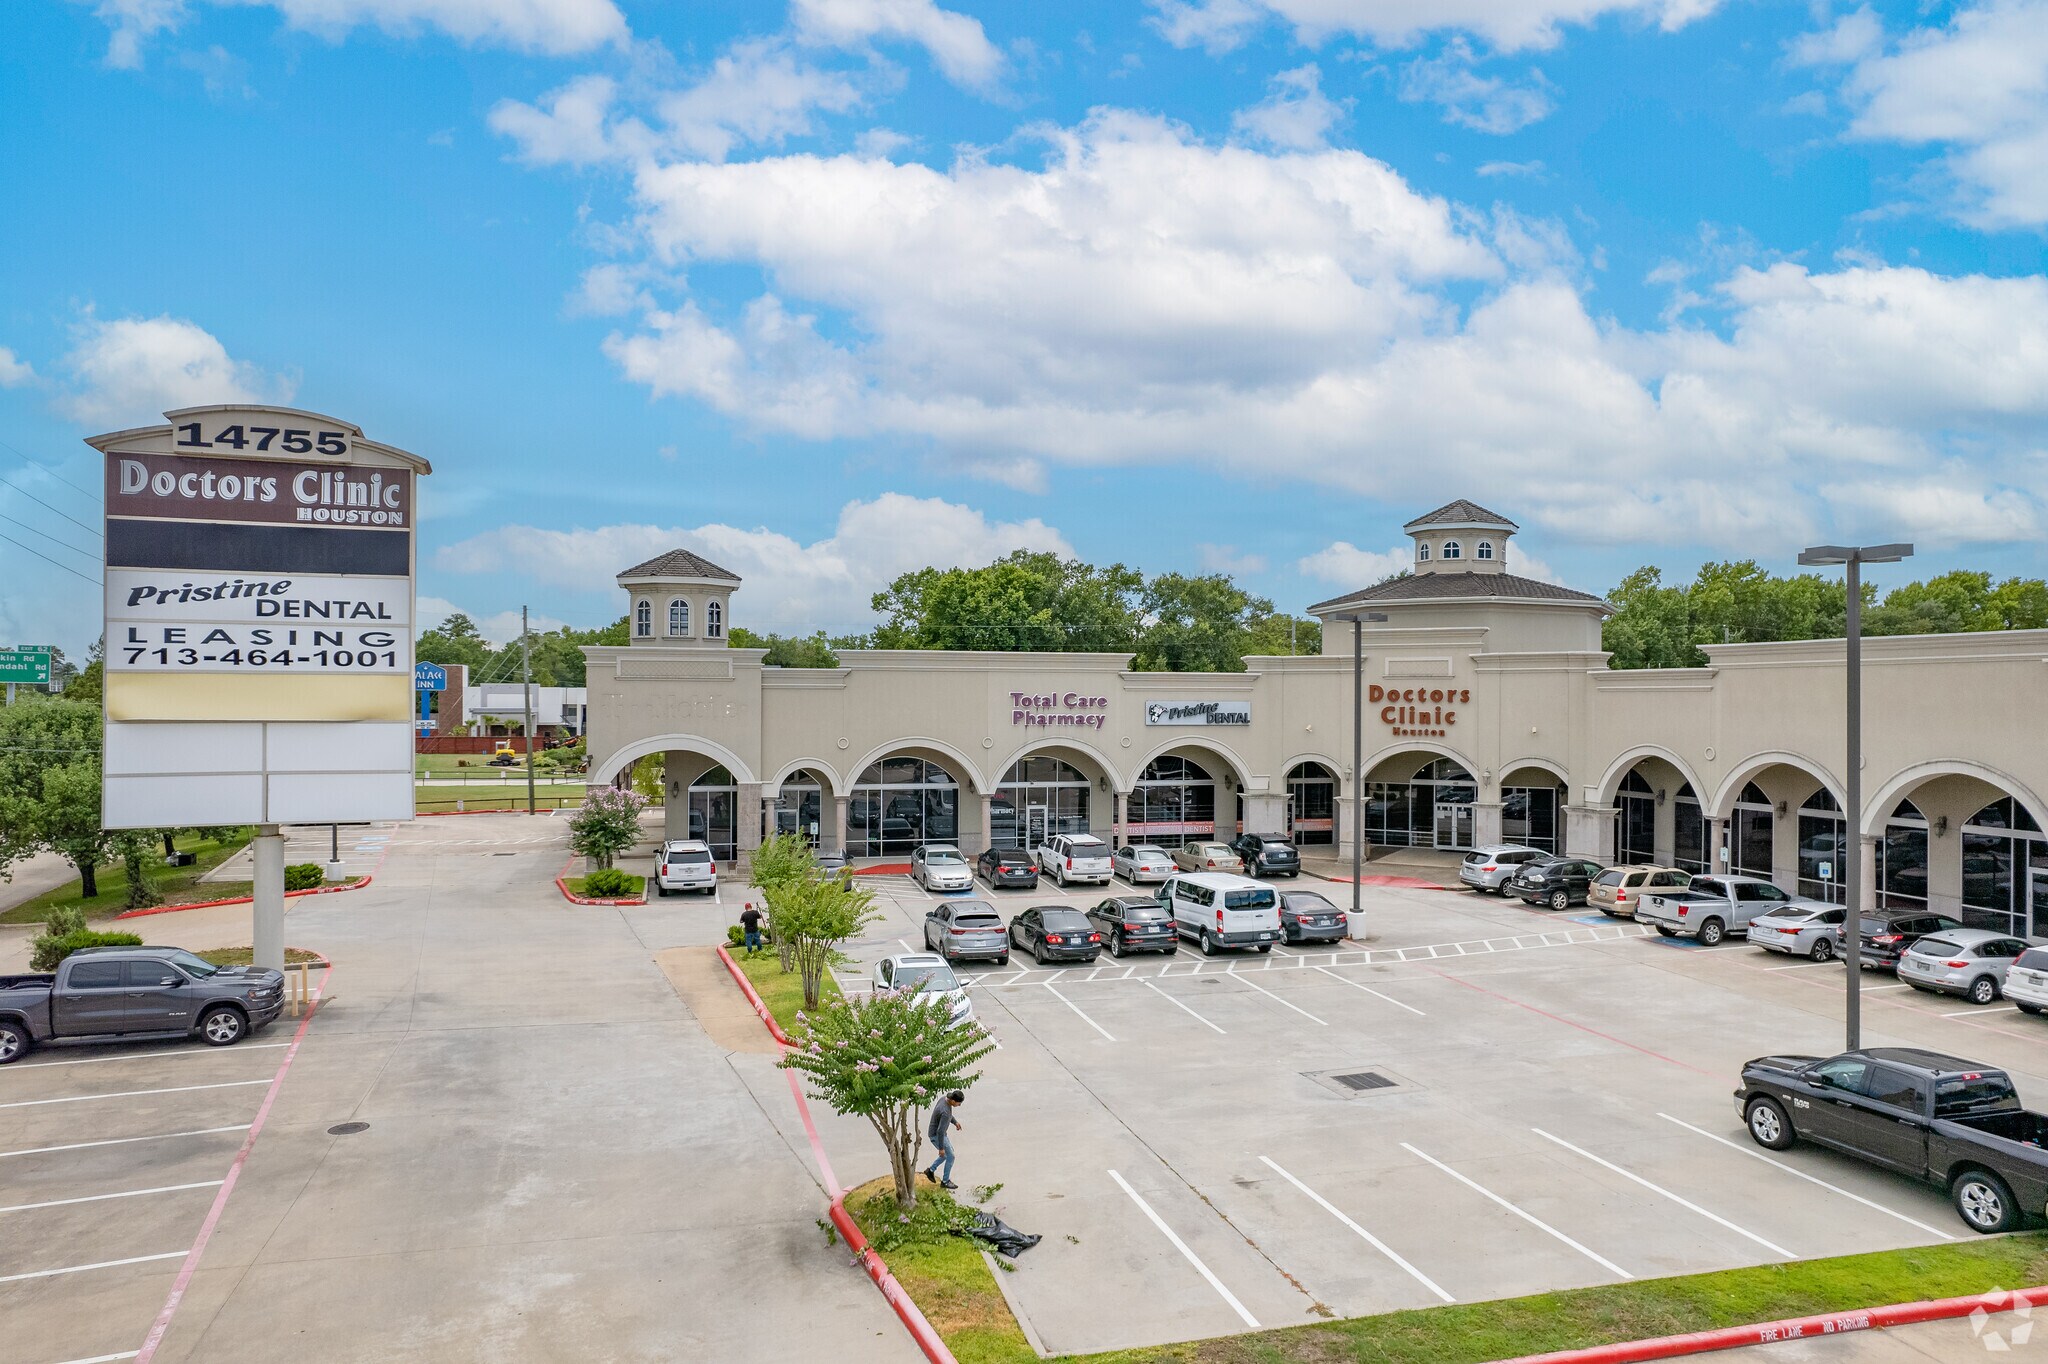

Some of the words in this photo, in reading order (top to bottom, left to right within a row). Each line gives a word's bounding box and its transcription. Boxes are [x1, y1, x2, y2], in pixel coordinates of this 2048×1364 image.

[177, 423, 347, 455] 14755
[120, 459, 277, 502] Doctors
[293, 470, 400, 508] Clinic
[296, 507, 403, 524] HOUSTON
[127, 579, 292, 607] Pristine
[256, 599, 392, 620] DENTAL
[128, 627, 395, 647] LEASING
[123, 648, 395, 667] 713-464-1001
[415, 671, 442, 680] ALACE
[1009, 692, 1057, 708] Total
[1063, 692, 1108, 708] Care
[1369, 684, 1470, 703] Doctors
[1012, 710, 1106, 730] Pharmacy
[1168, 702, 1219, 719] Pristine
[1206, 712, 1250, 724] DENTAL
[1381, 705, 1456, 725] Clinic
[1392, 726, 1446, 737] Houston
[1184, 825, 1213, 833] DENTIST
[1760, 1328, 1779, 1342] FIRE
[1782, 1325, 1803, 1339] LANE
[1822, 1320, 1835, 1333] NO
[1838, 1316, 1870, 1332] PARKING
